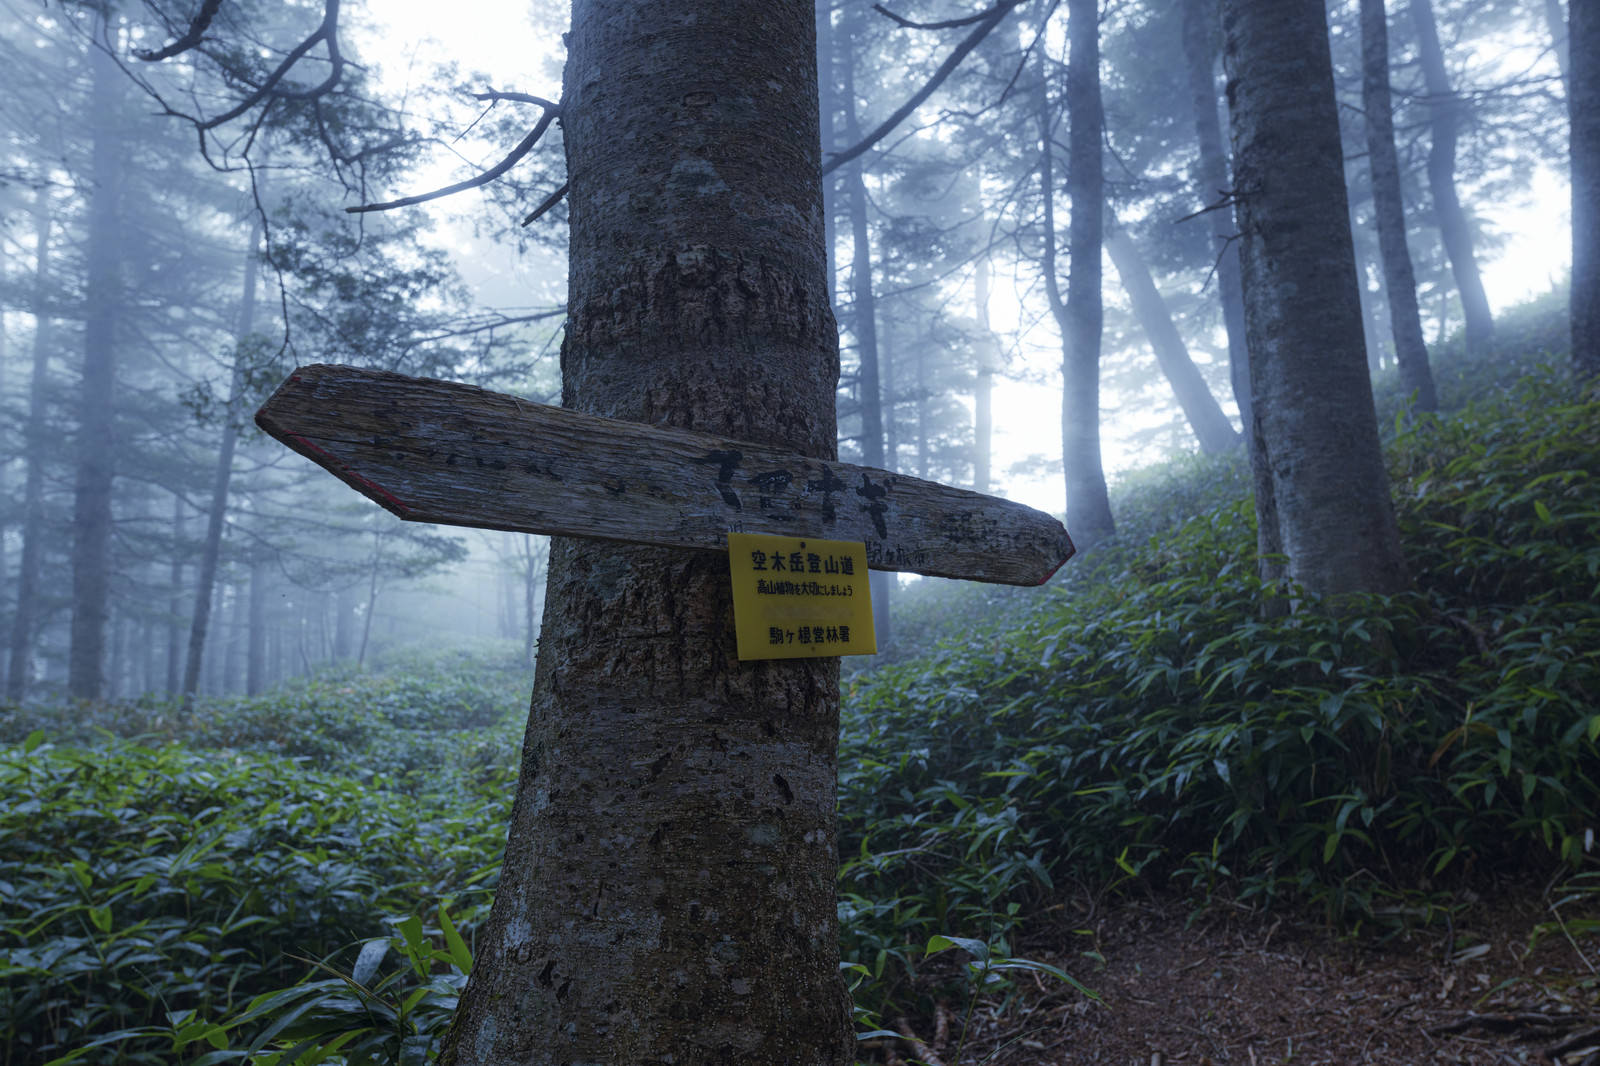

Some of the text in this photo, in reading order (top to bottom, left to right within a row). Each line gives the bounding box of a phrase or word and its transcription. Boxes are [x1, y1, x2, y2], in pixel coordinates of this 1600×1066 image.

[752, 550, 855, 575] 空木岳登山道
[758, 579, 853, 597] 高山植物を大切にしましょう
